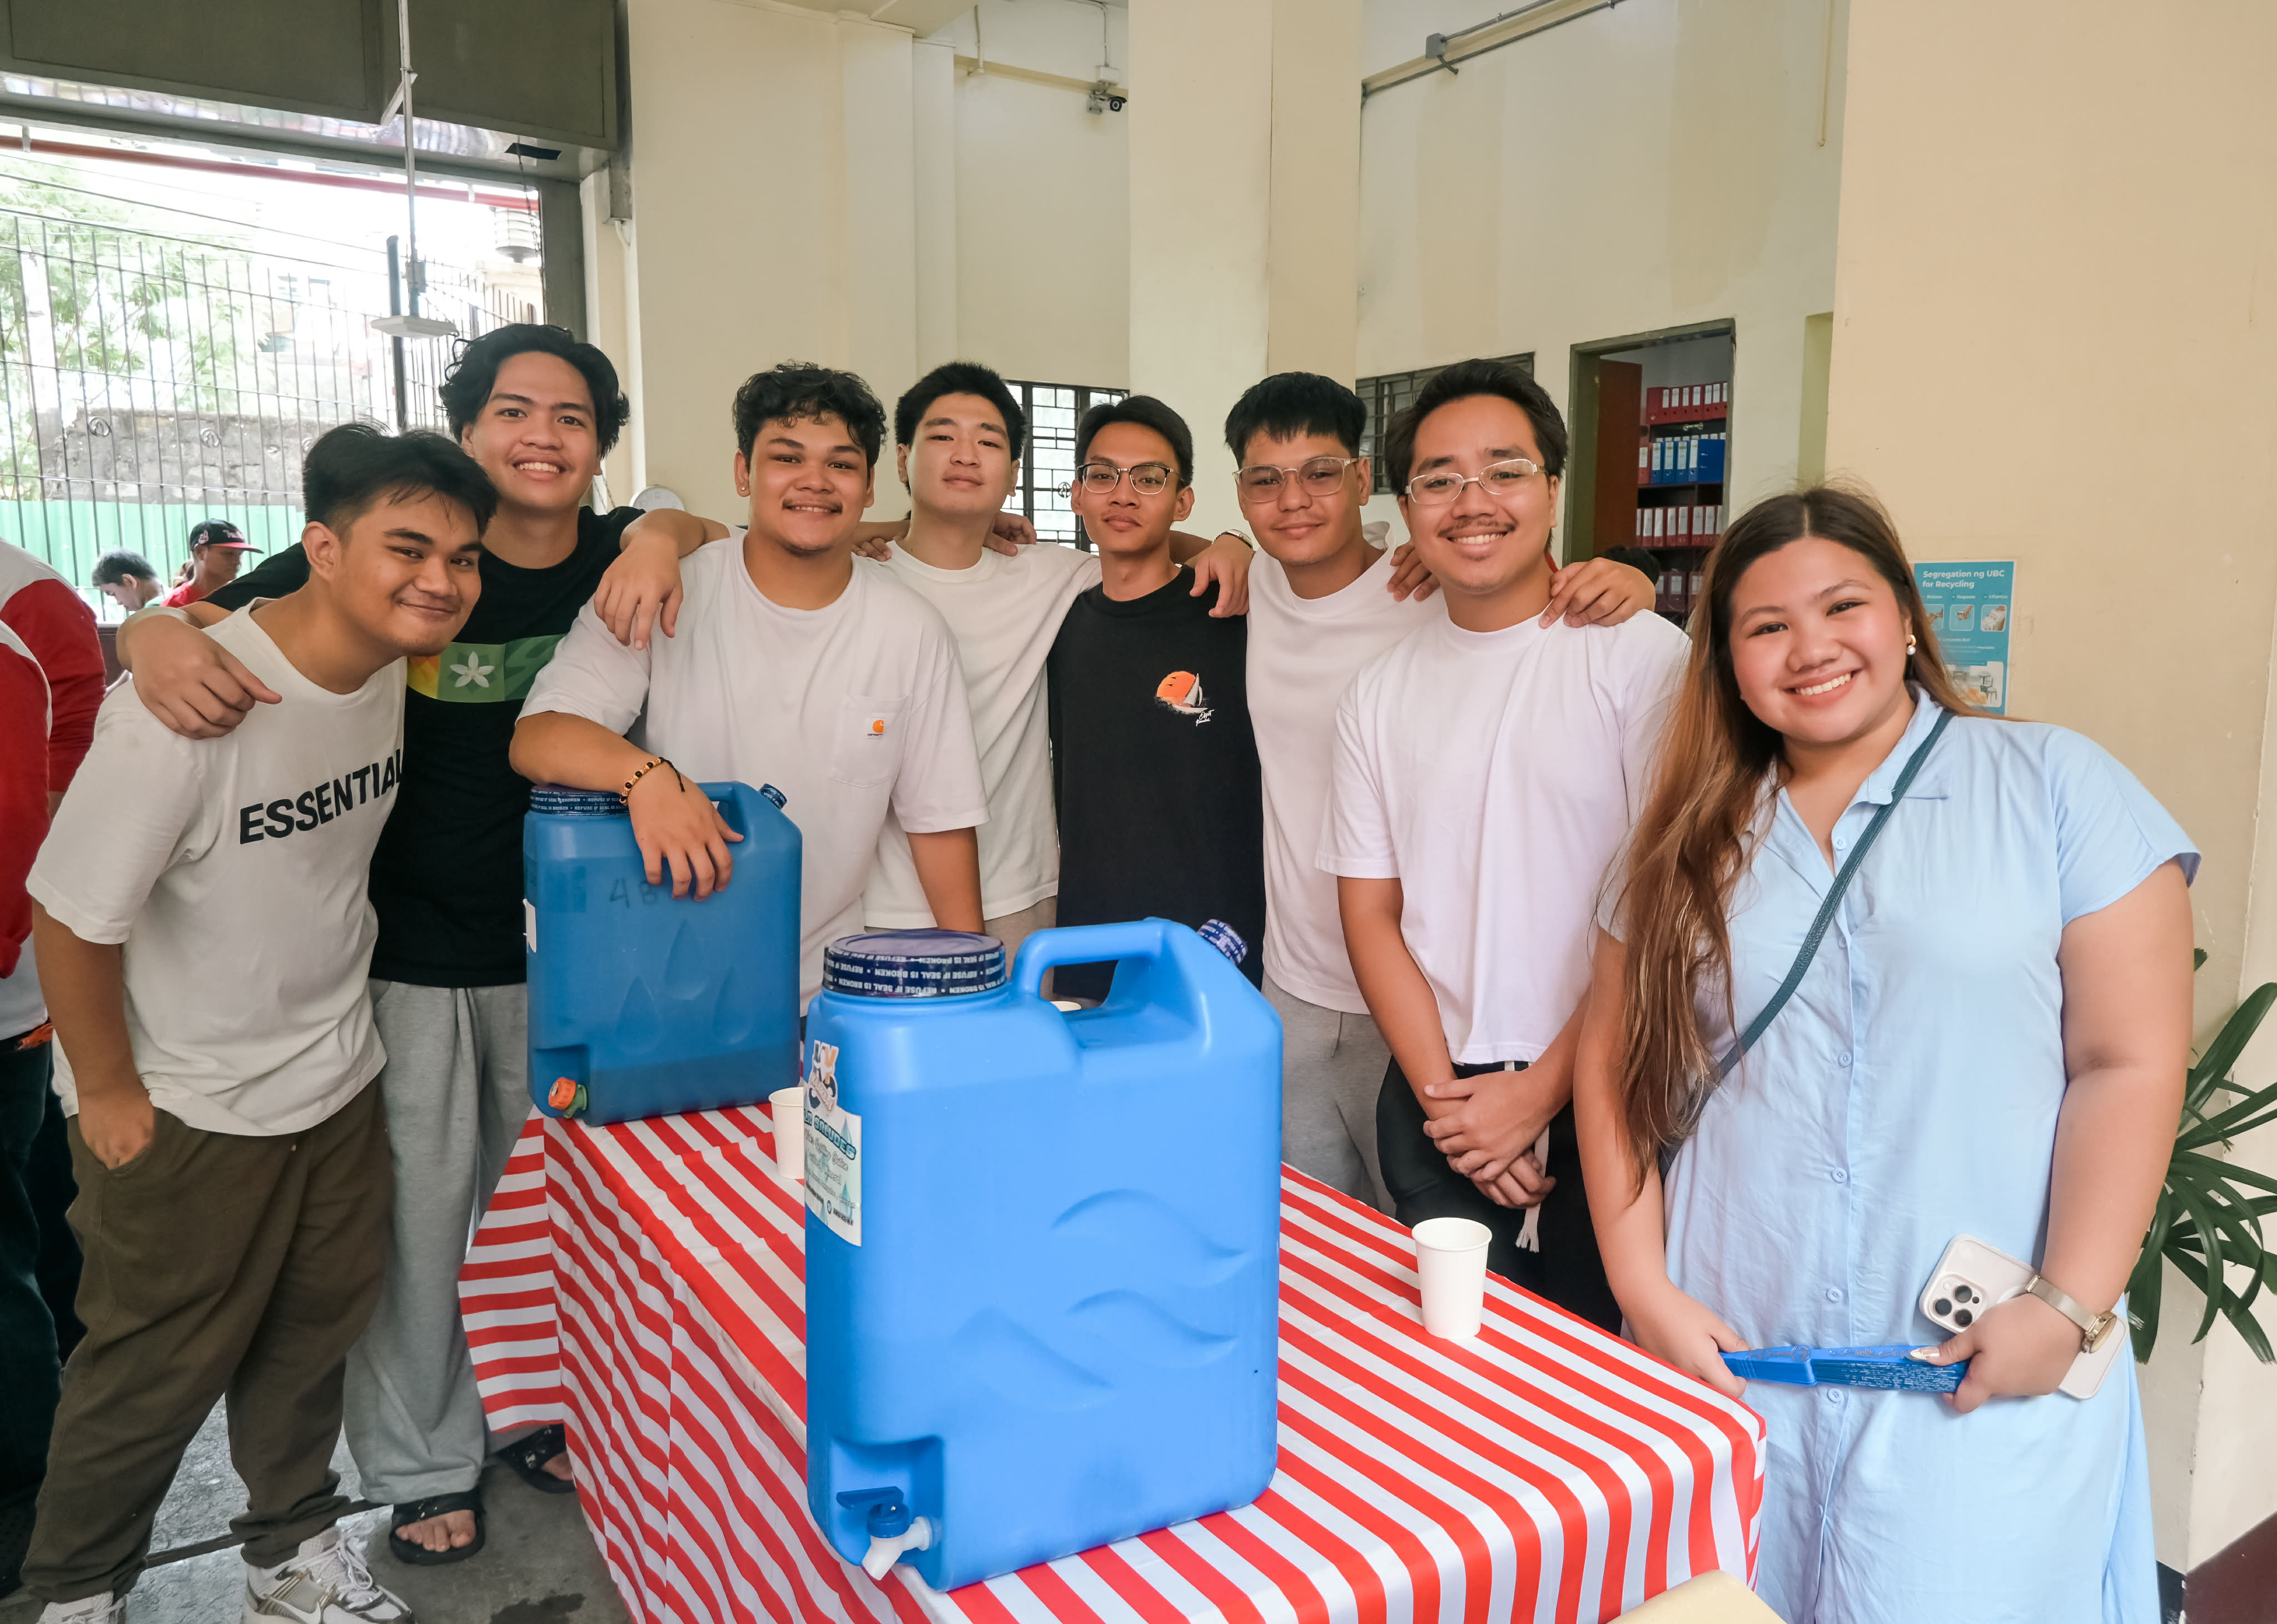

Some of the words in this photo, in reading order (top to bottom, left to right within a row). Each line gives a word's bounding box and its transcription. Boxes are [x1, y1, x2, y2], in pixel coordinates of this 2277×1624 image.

[1923, 570, 1971, 579] Segregation
[1936, 579, 1975, 589] Recycling
[841, 963, 863, 974] REFUSE
[874, 968, 908, 979] BROKEN
[952, 971, 977, 979] REFUSE
[839, 978, 863, 989] BROKEN
[864, 982, 872, 990] IS
[873, 983, 893, 992] SEAL
[905, 986, 937, 995] REFUSE
[949, 985, 978, 994] BROKEN
[814, 1115, 857, 1160] SALUDES
